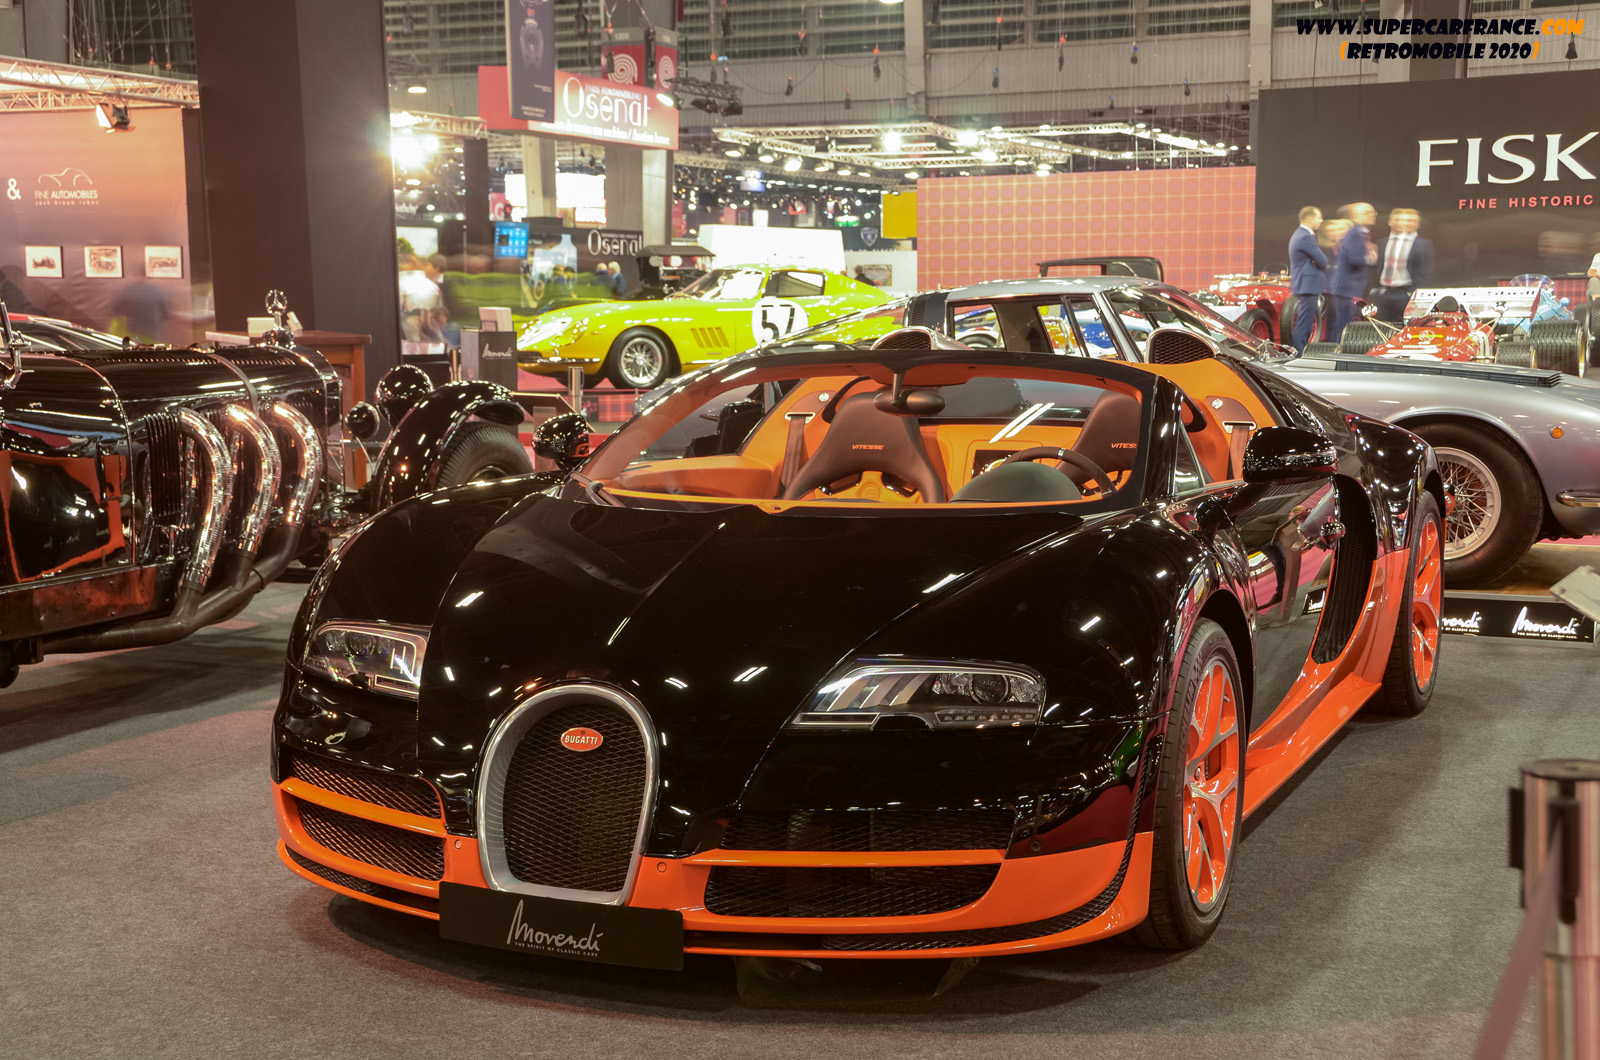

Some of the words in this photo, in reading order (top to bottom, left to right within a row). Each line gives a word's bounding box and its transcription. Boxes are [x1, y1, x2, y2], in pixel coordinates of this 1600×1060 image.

[563, 76, 651, 127] Osenat
[1416, 131, 1600, 187] FISK
[7, 177, 22, 200] &
[35, 190, 49, 199] FINE
[51, 190, 98, 199] AUTOMOBILES
[1458, 198, 1497, 210] FINE
[1508, 194, 1594, 209] HISTORIC
[564, 735, 598, 745] BUGATTI
[506, 899, 604, 951] Movendi
